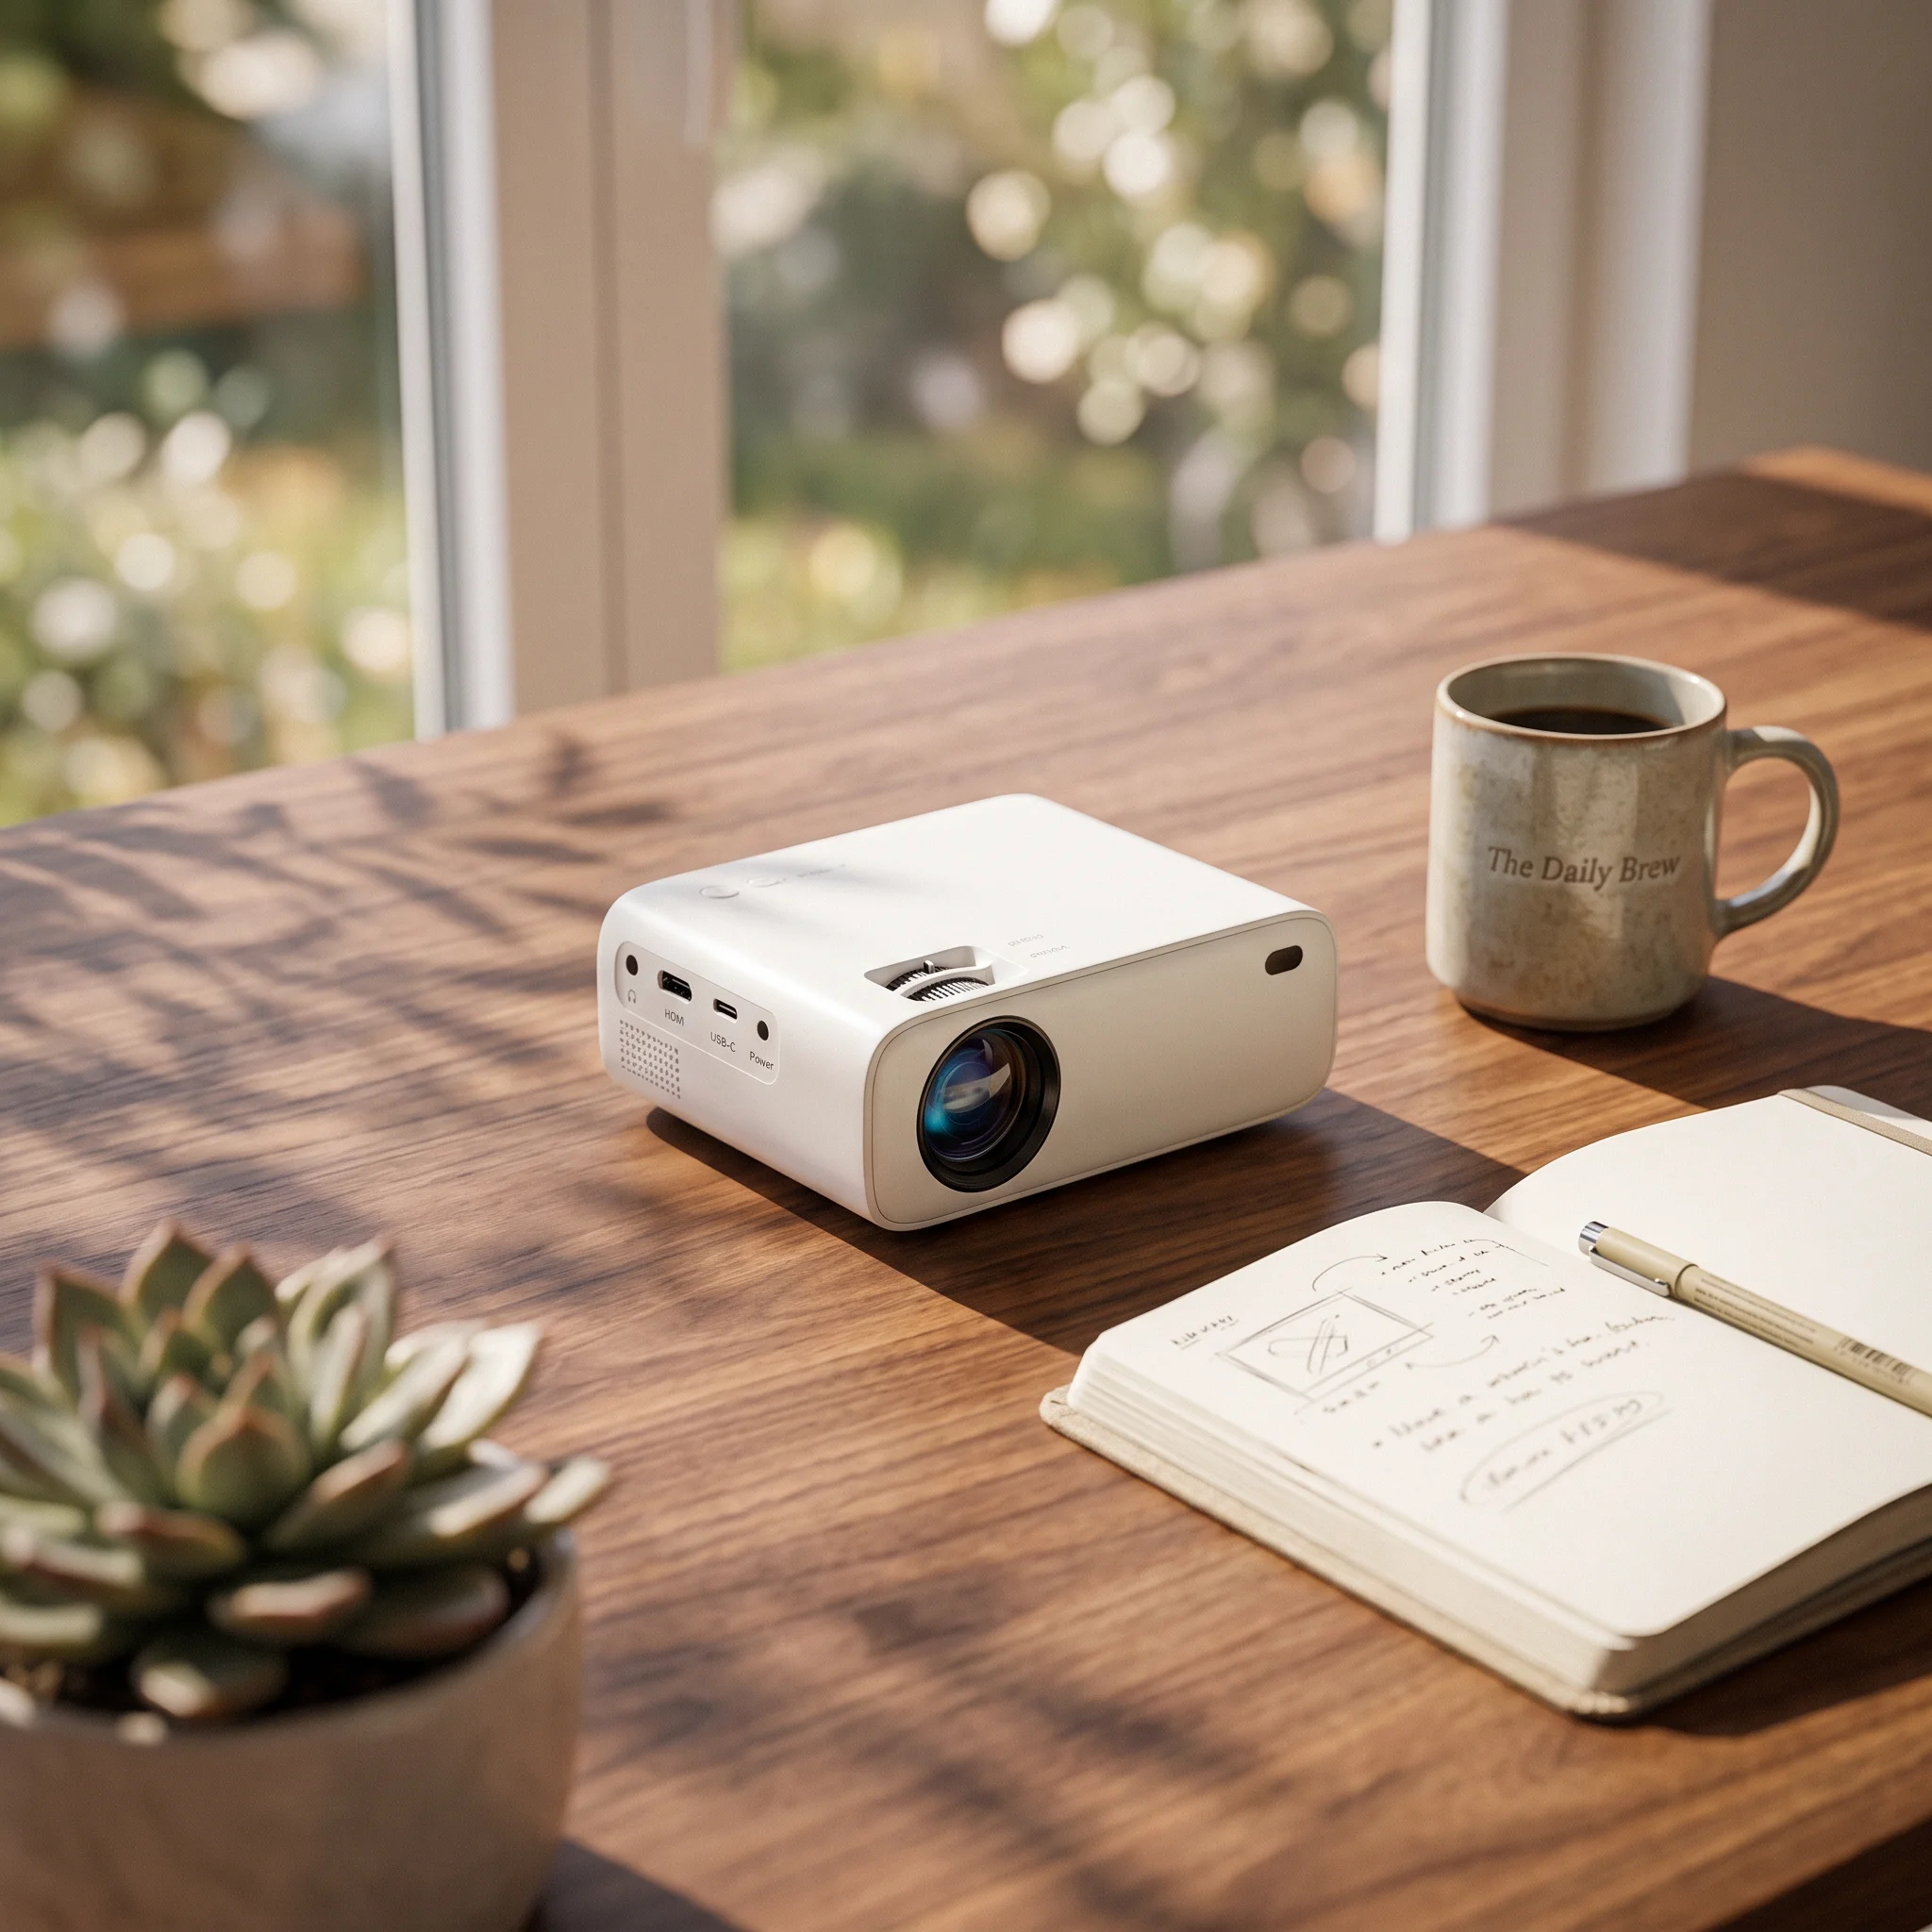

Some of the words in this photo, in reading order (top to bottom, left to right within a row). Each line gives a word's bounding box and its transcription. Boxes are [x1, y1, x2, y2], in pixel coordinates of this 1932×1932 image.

[1488, 846, 1534, 878] The
[1541, 856, 1613, 891] Daily
[1619, 857, 1681, 883] Brew
[710, 1031, 736, 1052] USB-C
[749, 1051, 774, 1070] Power
